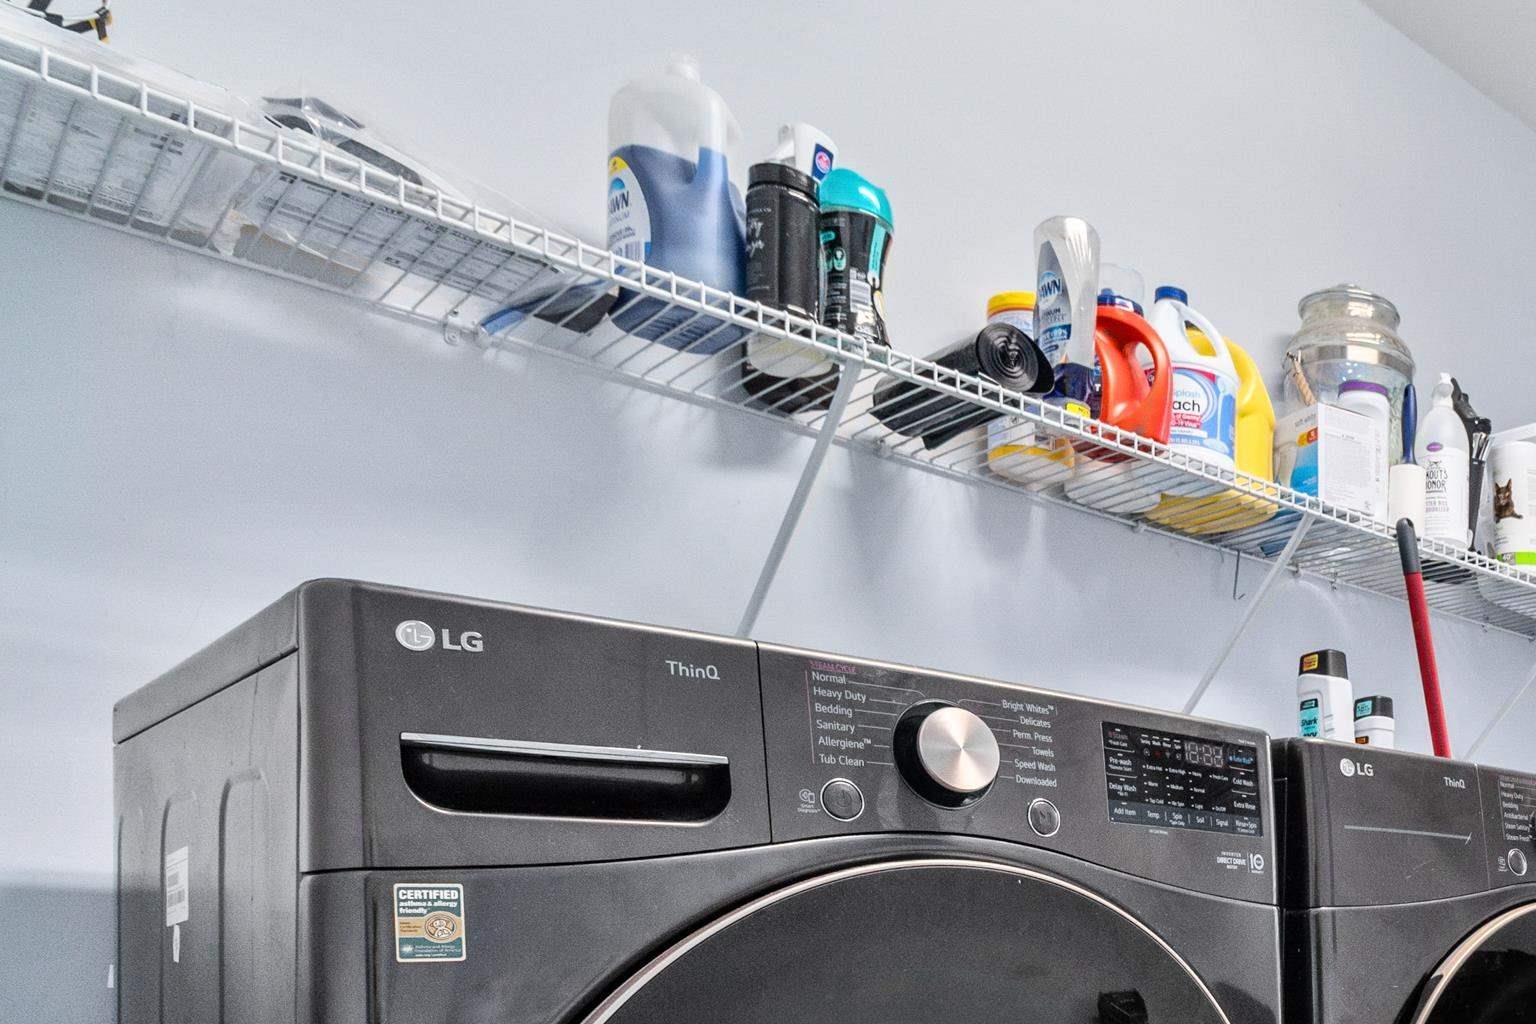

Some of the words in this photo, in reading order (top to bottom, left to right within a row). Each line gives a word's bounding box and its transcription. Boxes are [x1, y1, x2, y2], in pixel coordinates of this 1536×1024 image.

[442, 628, 484, 652] LG
[665, 659, 721, 681] ThinQ
[811, 671, 846, 684] Normal
[813, 686, 842, 700] Heavy
[844, 689, 866, 703] Duty
[815, 702, 853, 718] Bedding
[1002, 699, 1024, 712] Bright
[816, 719, 855, 734] Sanitary
[1020, 716, 1051, 728] Delicates
[1012, 729, 1032, 740] Perm.
[1034, 732, 1053, 743] Press
[1032, 746, 1054, 758] Towels
[819, 753, 836, 764] Tub
[838, 755, 865, 767] Clean
[1014, 758, 1036, 770] Speed
[1037, 761, 1056, 772] Wash
[1356, 762, 1374, 777] LG
[1015, 774, 1057, 787] Downloaded
[1443, 776, 1466, 789] ThinQ
[1250, 852, 1264, 871] 10
[399, 889, 459, 900] CERTIFIED
[433, 900, 458, 908] allergy
